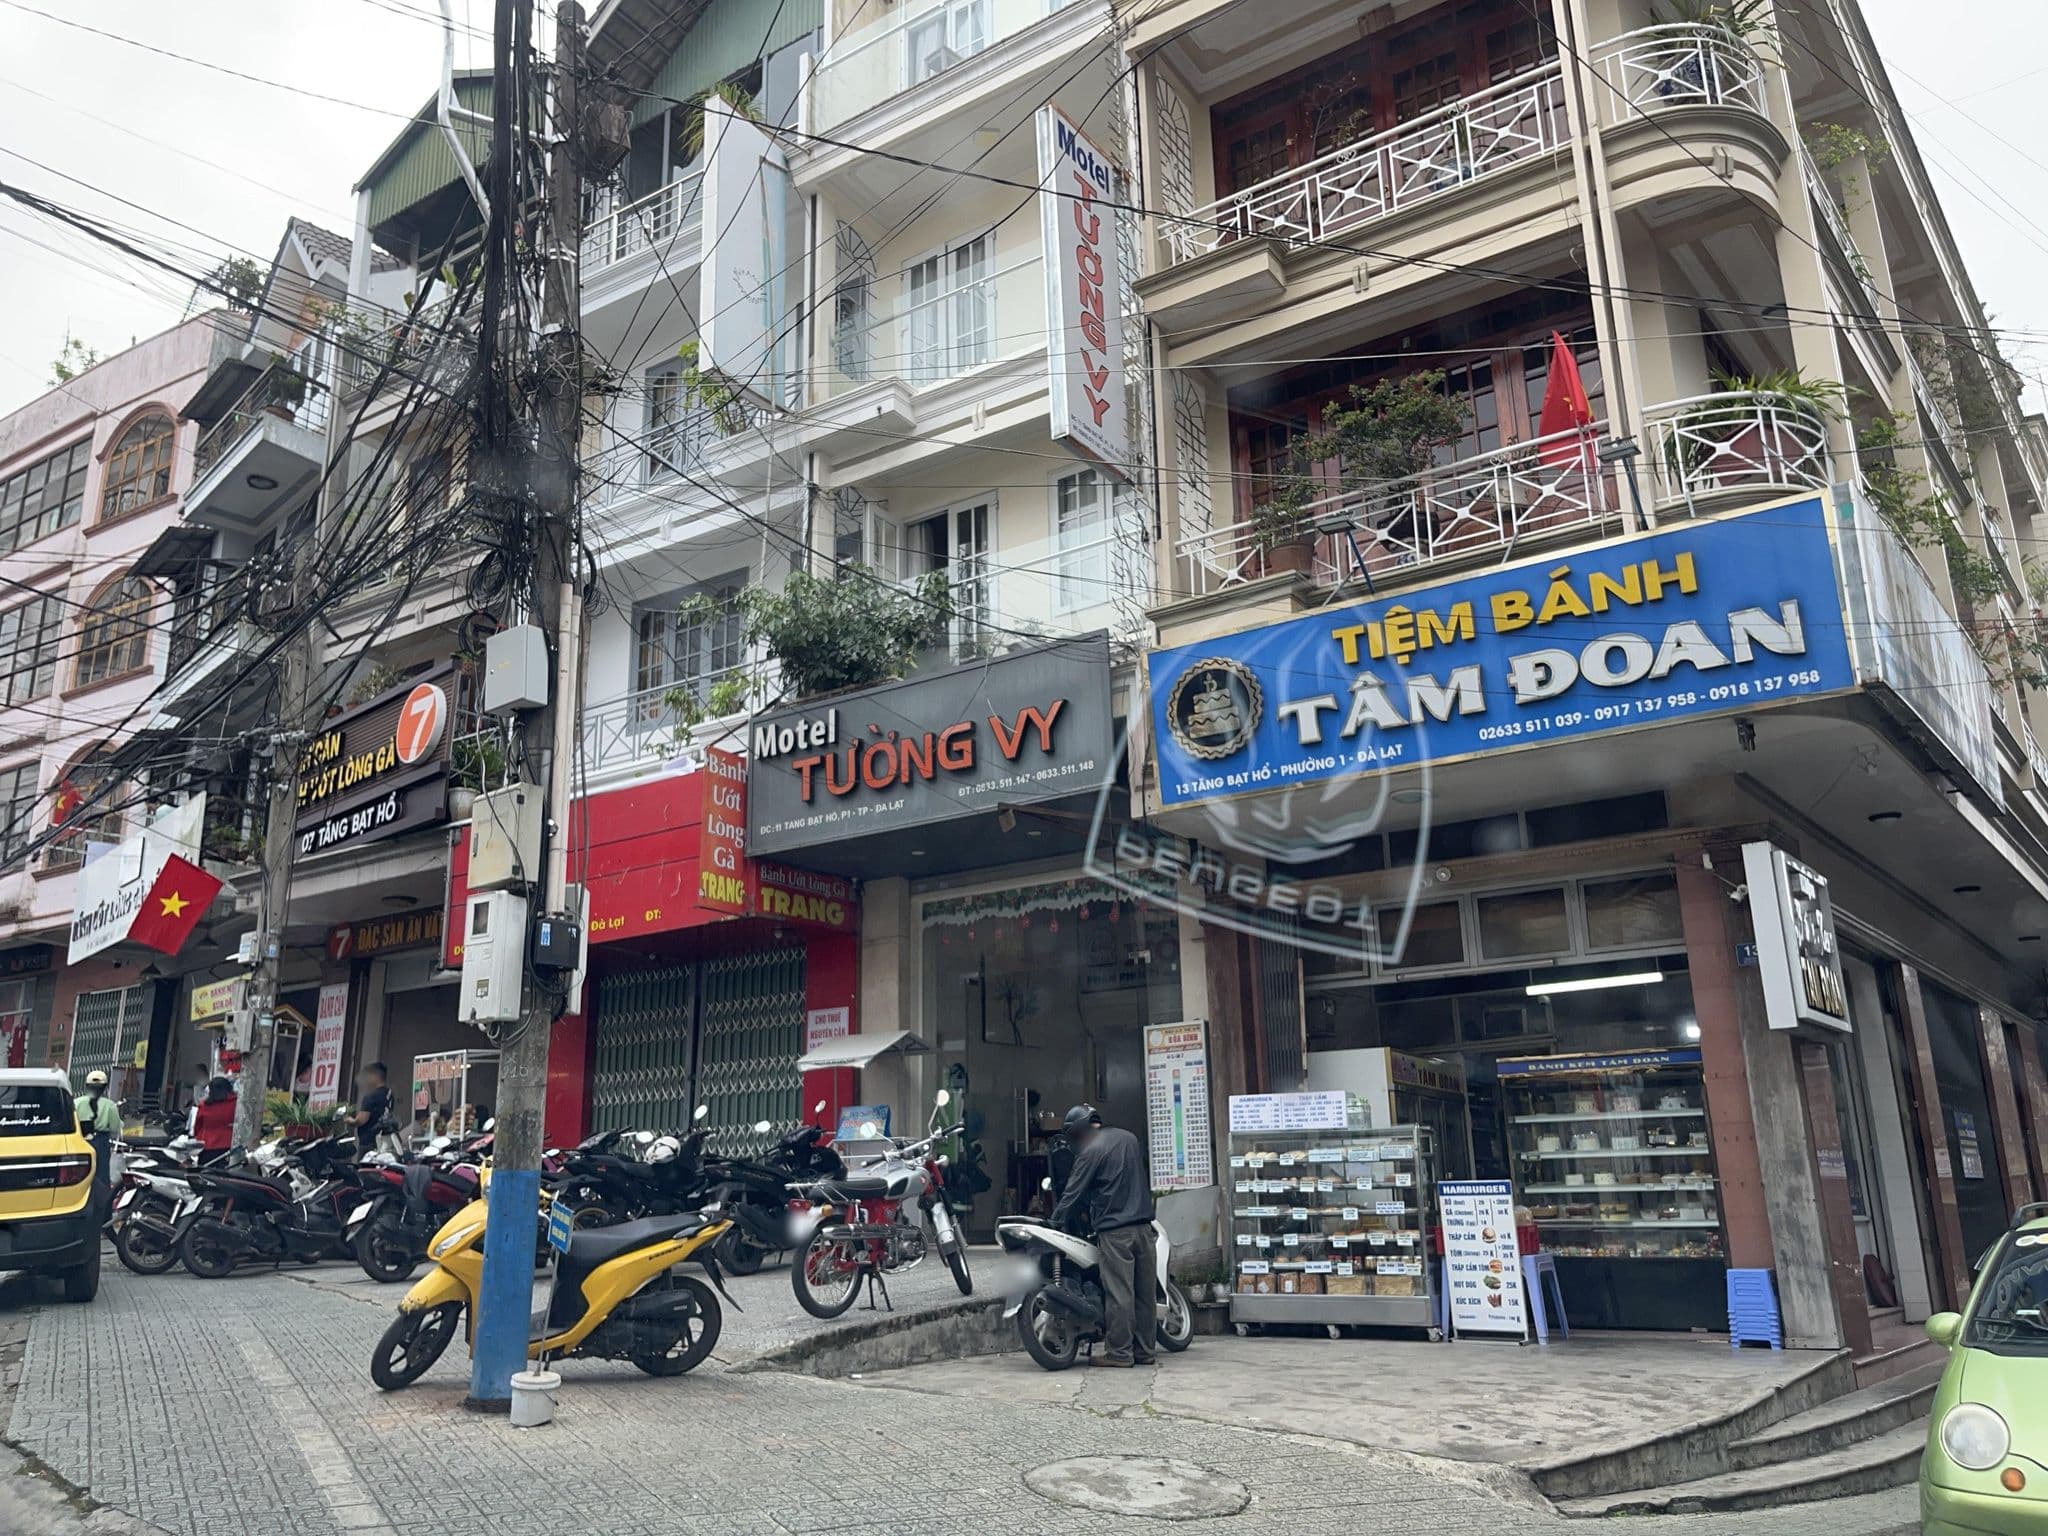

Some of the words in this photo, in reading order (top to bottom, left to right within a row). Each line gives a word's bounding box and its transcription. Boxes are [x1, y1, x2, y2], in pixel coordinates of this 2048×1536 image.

[1057, 119, 1111, 195] Motel
[1079, 347, 1111, 428] VY
[1331, 601, 1476, 664] TIỆM
[1490, 552, 1698, 633] BÁNH
[1278, 664, 1487, 745] TÂM
[1506, 599, 1807, 705] ĐOAN
[411, 693, 435, 761] 7
[1479, 723, 1521, 741] 02633
[1526, 718, 1550, 733] 511
[1555, 712, 1582, 727] 039
[1594, 704, 1630, 721] 0917
[1635, 697, 1662, 714] 137
[1668, 692, 1696, 708] 958
[1709, 682, 1749, 700] 0918
[1754, 676, 1783, 693] 137
[1788, 670, 1821, 686] 958
[754, 708, 836, 760] Motel
[792, 720, 974, 801] TƯỜNG
[988, 699, 1065, 760] VY
[337, 755, 372, 790] LÒNG
[376, 737, 396, 771] GÀ
[709, 754, 746, 784] Bánh
[1176, 784, 1189, 796] 13
[1192, 777, 1224, 793] TĂNG
[1227, 772, 1249, 787] BẠT
[1280, 757, 1335, 776] PHƯỜNG
[1339, 755, 1346, 766] 1
[1357, 745, 1378, 763] ĐÀ
[1380, 744, 1403, 760] LẠT
[713, 785, 741, 811] Ướt
[302, 832, 315, 853] 07
[318, 817, 348, 846] TĂNG
[352, 807, 375, 835] BẠT
[707, 813, 744, 848] Lòng
[714, 847, 735, 871] Gà
[702, 871, 745, 905] TRANG
[761, 887, 845, 926] TRANG
[336, 928, 350, 960] 7
[591, 918, 606, 931] Đà
[315, 1063, 336, 1089] 07
[1443, 1185, 1507, 1194] HAMBURGER
